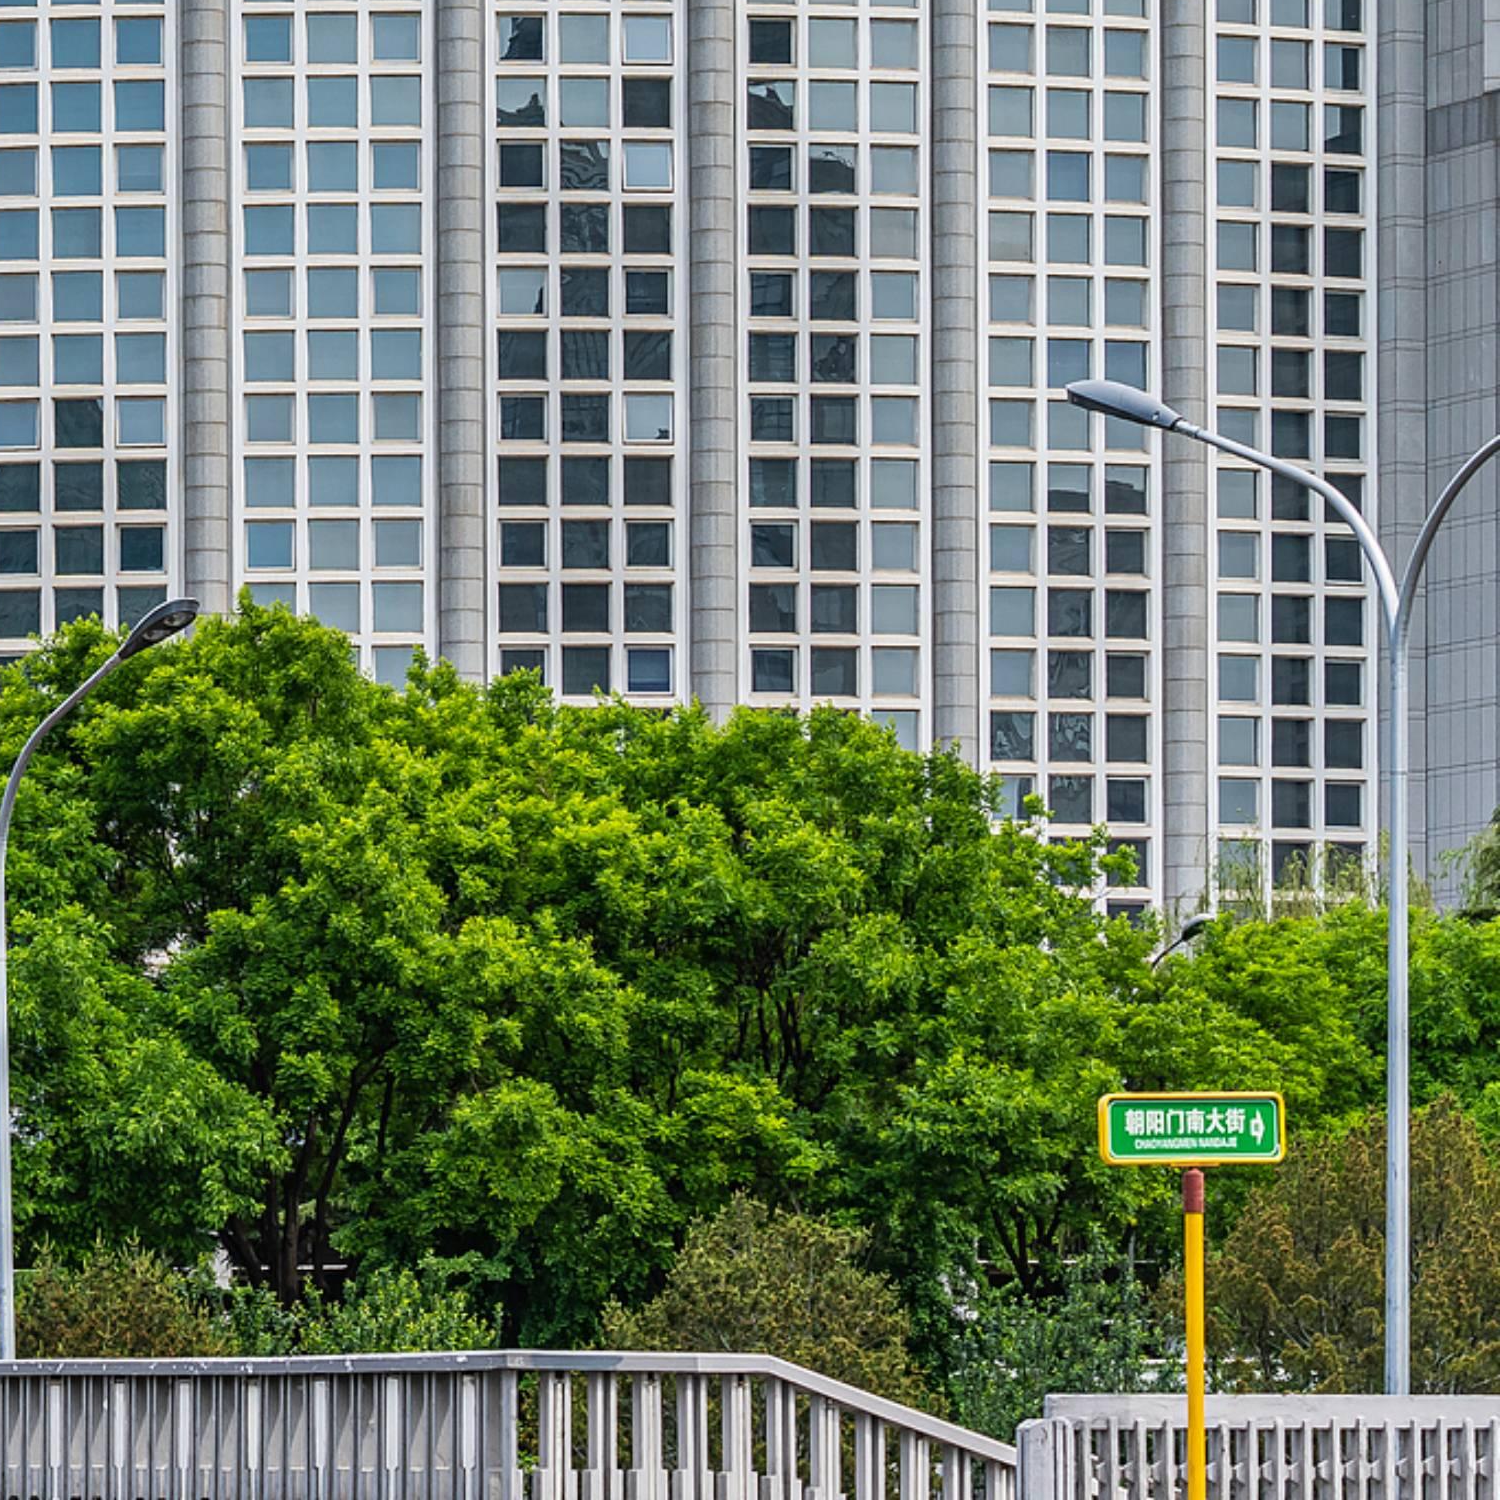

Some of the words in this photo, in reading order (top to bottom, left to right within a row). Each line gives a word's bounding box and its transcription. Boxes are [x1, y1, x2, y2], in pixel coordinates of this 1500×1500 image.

[1124, 1107, 1245, 1135] 朝阳门南大街
